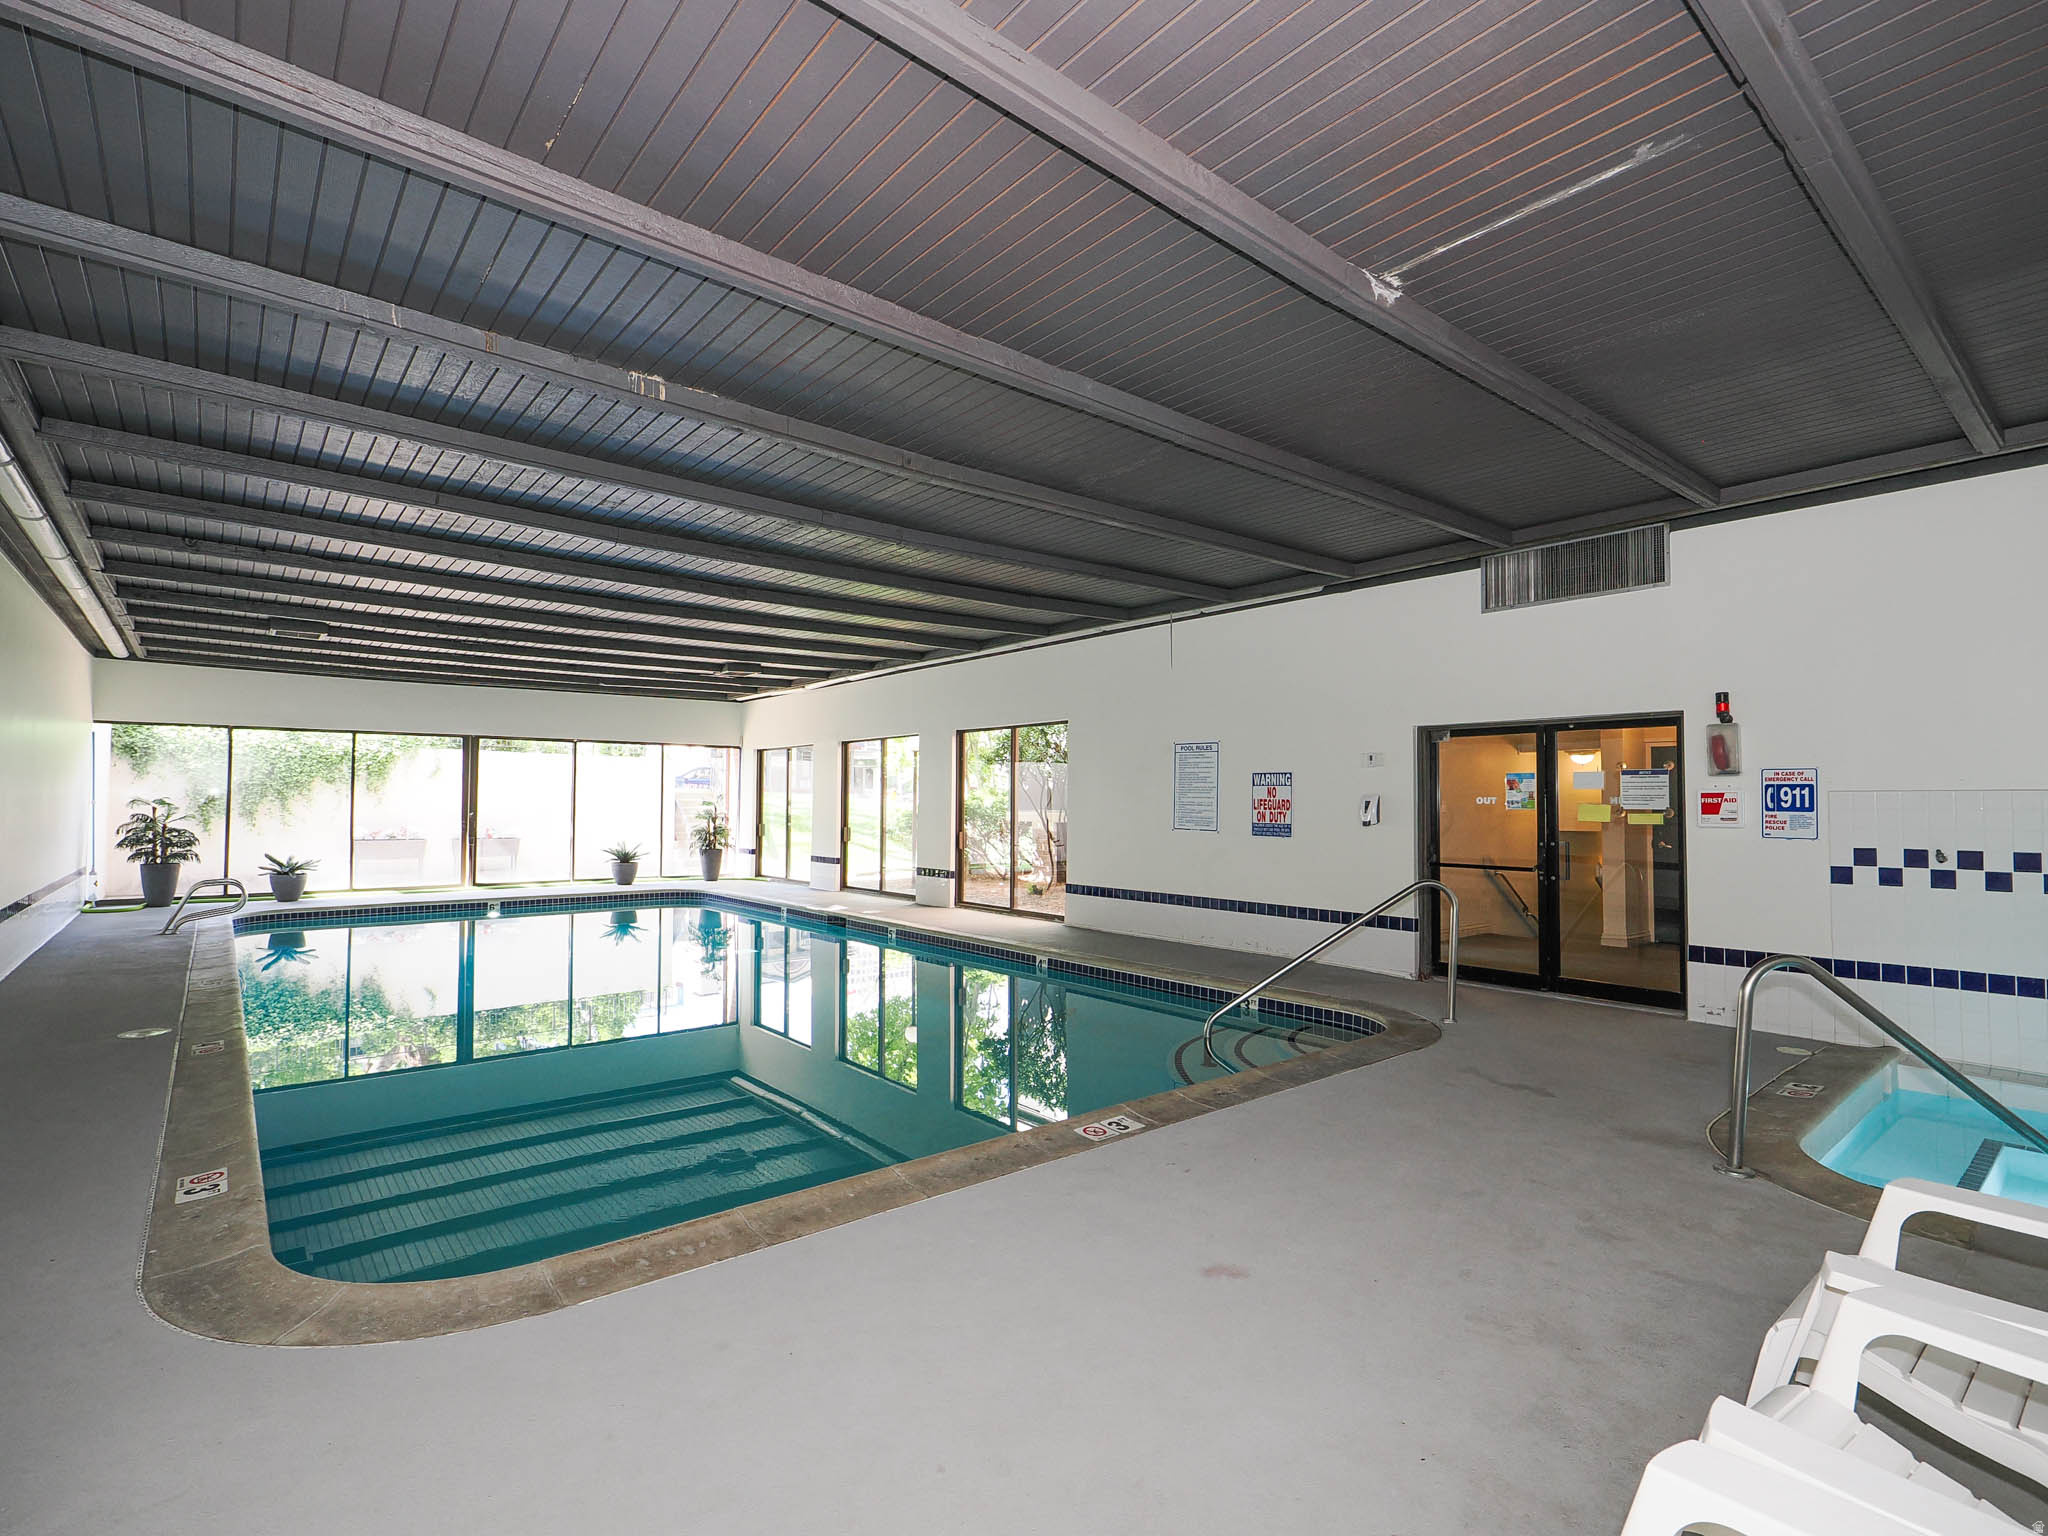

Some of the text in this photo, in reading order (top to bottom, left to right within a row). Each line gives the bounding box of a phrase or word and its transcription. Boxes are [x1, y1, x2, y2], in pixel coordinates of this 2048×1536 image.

[1253, 773, 1291, 786] WARNING
[1267, 787, 1277, 798] NO
[1780, 786, 1810, 808] 911
[1253, 798, 1291, 811] LIFEGUARD
[1475, 796, 1497, 805] OUT
[1257, 811, 1287, 823] ON DUTY
[1107, 1121, 1130, 1131] 3
[183, 1183, 220, 1195] 3
